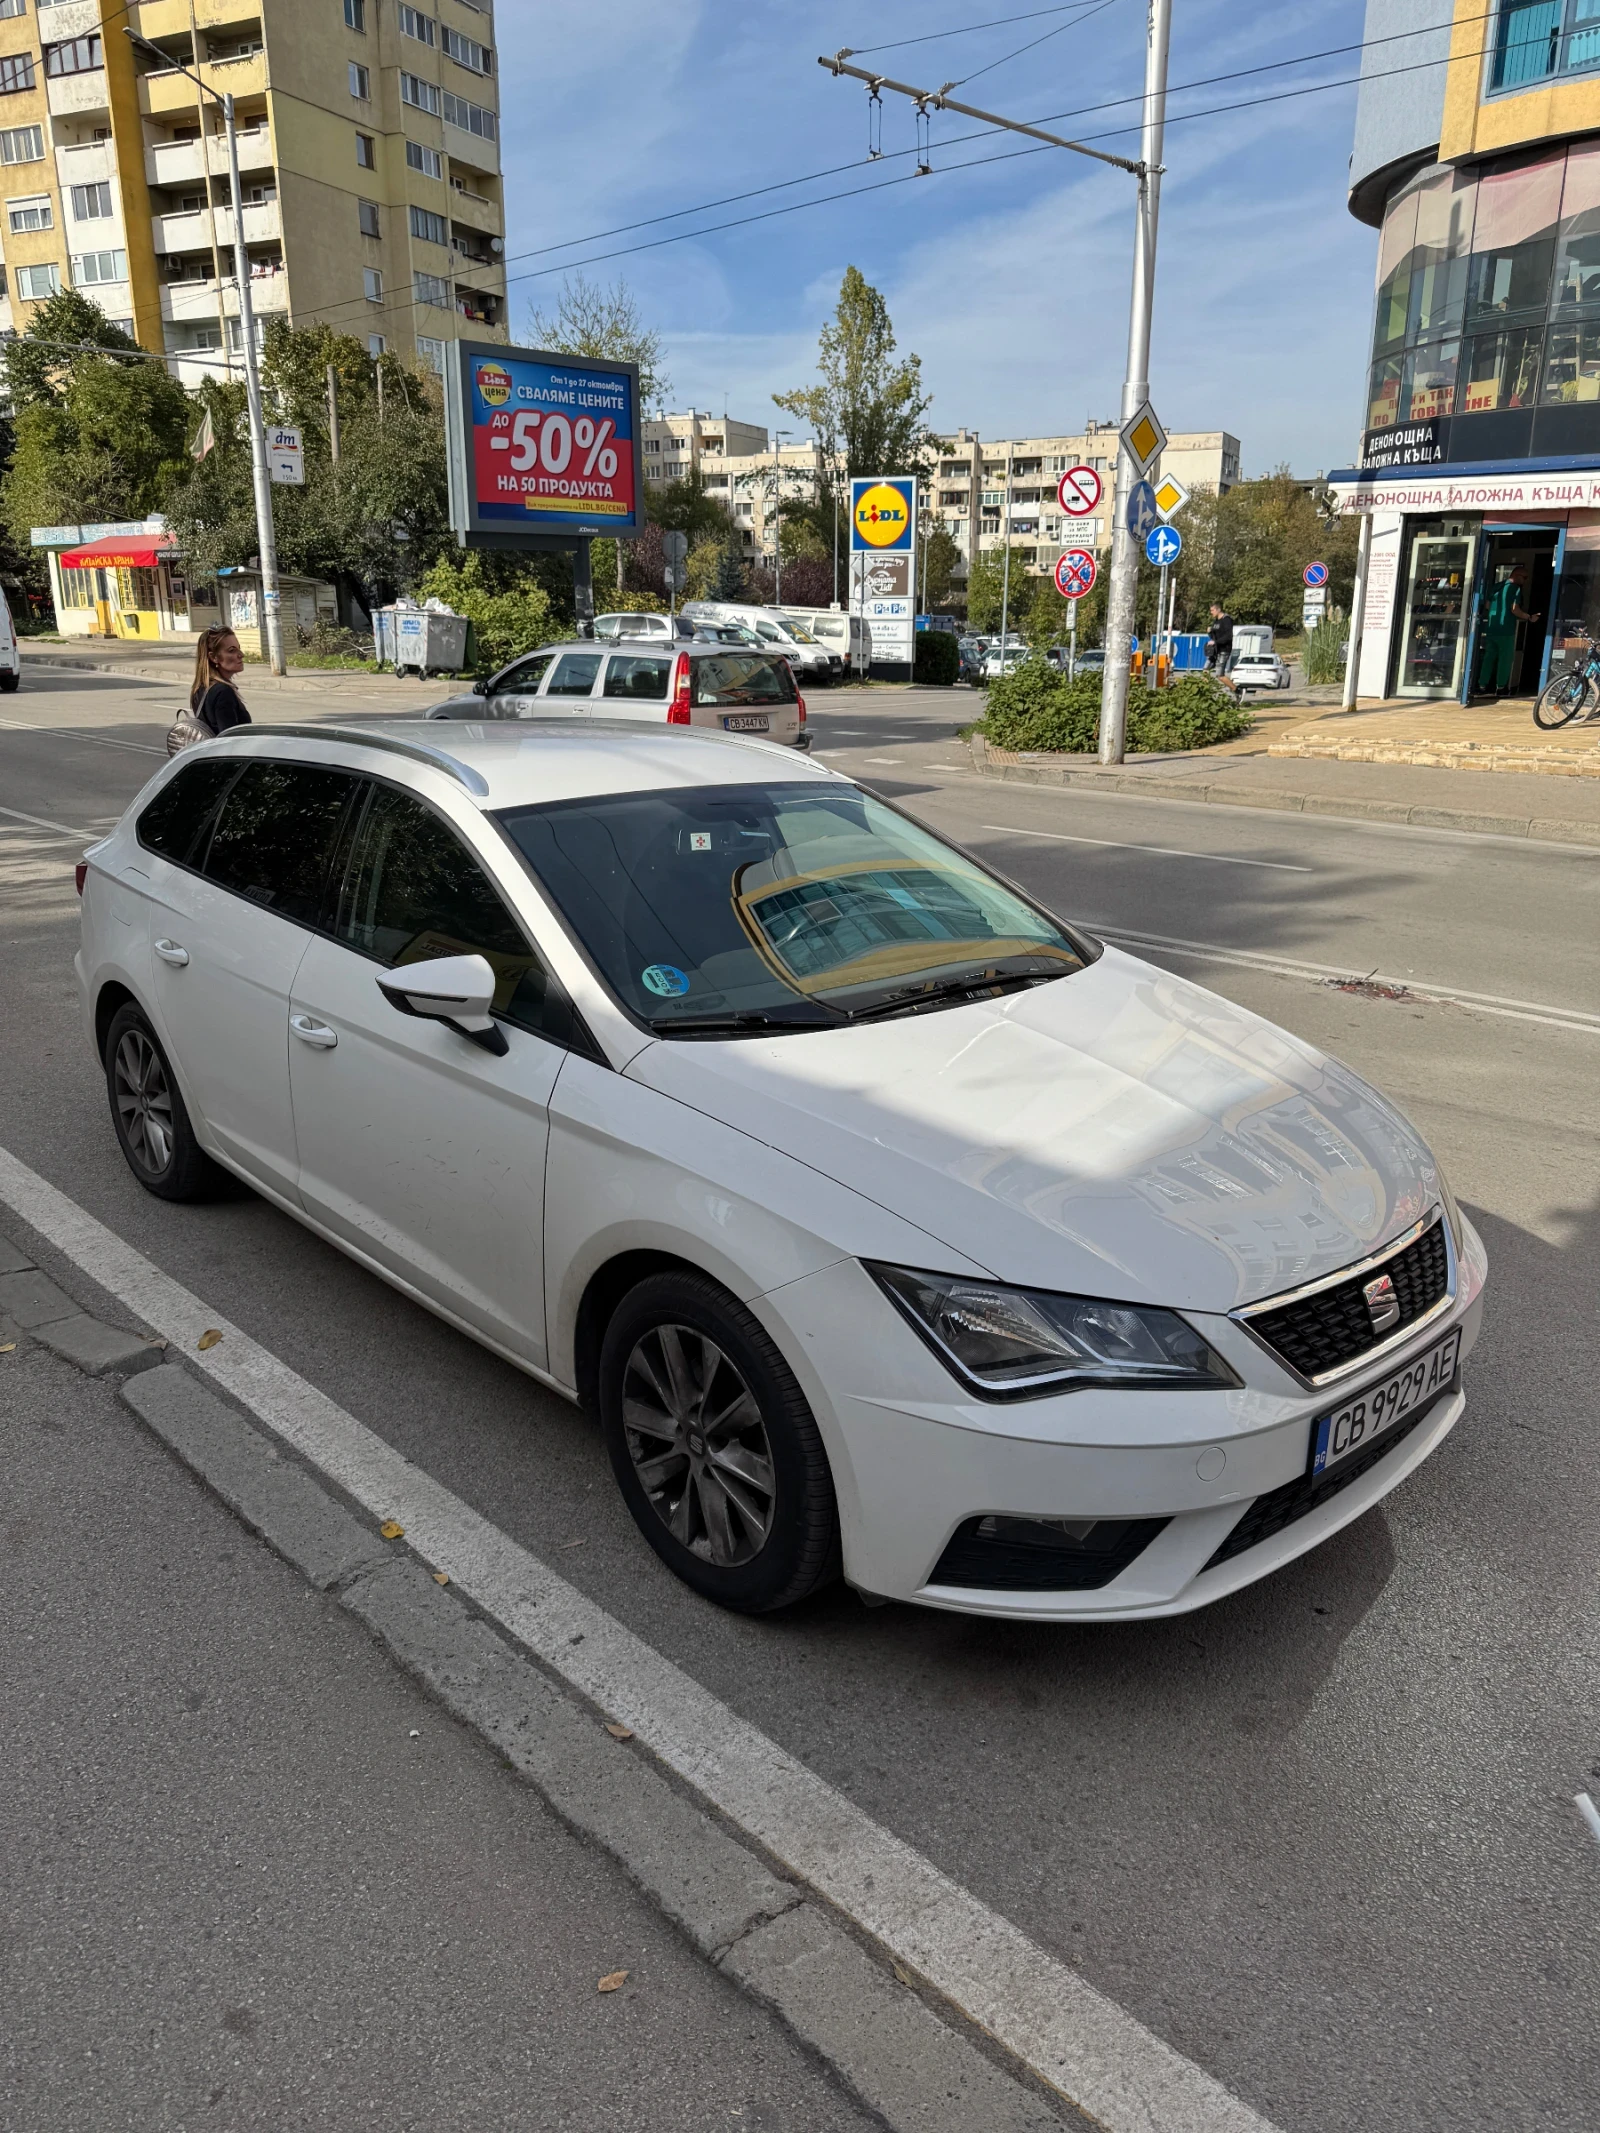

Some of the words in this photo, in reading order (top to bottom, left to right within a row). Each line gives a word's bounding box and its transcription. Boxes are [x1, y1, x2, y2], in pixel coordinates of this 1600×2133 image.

[484, 386, 507, 398] цена
[578, 379, 586, 387] 27
[588, 380, 624, 392] октомври
[517, 385, 576, 405] СВАЛЯМЕ
[578, 392, 624, 410] ЦЕНИТЕ
[492, 414, 509, 428] ДО
[275, 431, 295, 445] dm
[490, 412, 618, 478] -50%
[1368, 426, 1433, 455] ДЕНОНОЩНА
[1362, 451, 1401, 470] ЗАЛОЖНА
[1403, 445, 1442, 464] КЪЩА
[497, 475, 519, 491] НА
[521, 477, 536, 492] 50
[538, 478, 614, 498] ПРОДУКТА
[1344, 489, 1443, 510] ДЕНОНОЩНА
[1532, 485, 1584, 503] КЪЩА
[113, 555, 135, 565] ХРАНА
[730, 719, 740, 729] CB
[741, 718, 758, 728] 3447
[1332, 1402, 1366, 1455] CB
[1372, 1362, 1426, 1432] 9929
[1425, 1339, 1455, 1394] AE
[1314, 1450, 1326, 1466] BG
